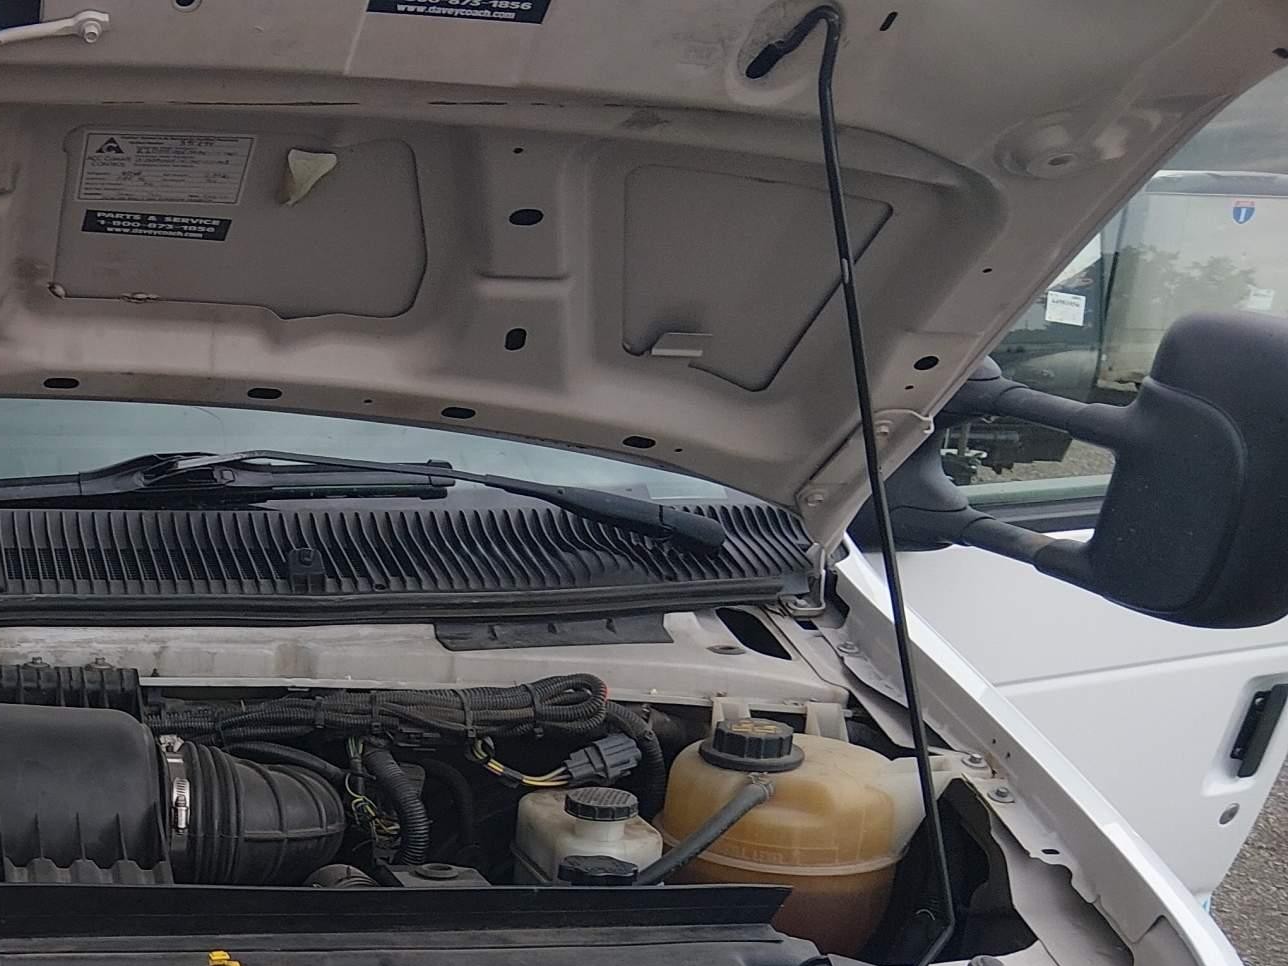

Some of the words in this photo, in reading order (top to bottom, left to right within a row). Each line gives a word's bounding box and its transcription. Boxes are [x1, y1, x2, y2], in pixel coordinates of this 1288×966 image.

[396, 4, 515, 19] www.daveycoach.com
[96, 212, 141, 220] PARTS
[164, 216, 221, 226] SERVICE
[96, 219, 216, 233] 1-800-873-1856
